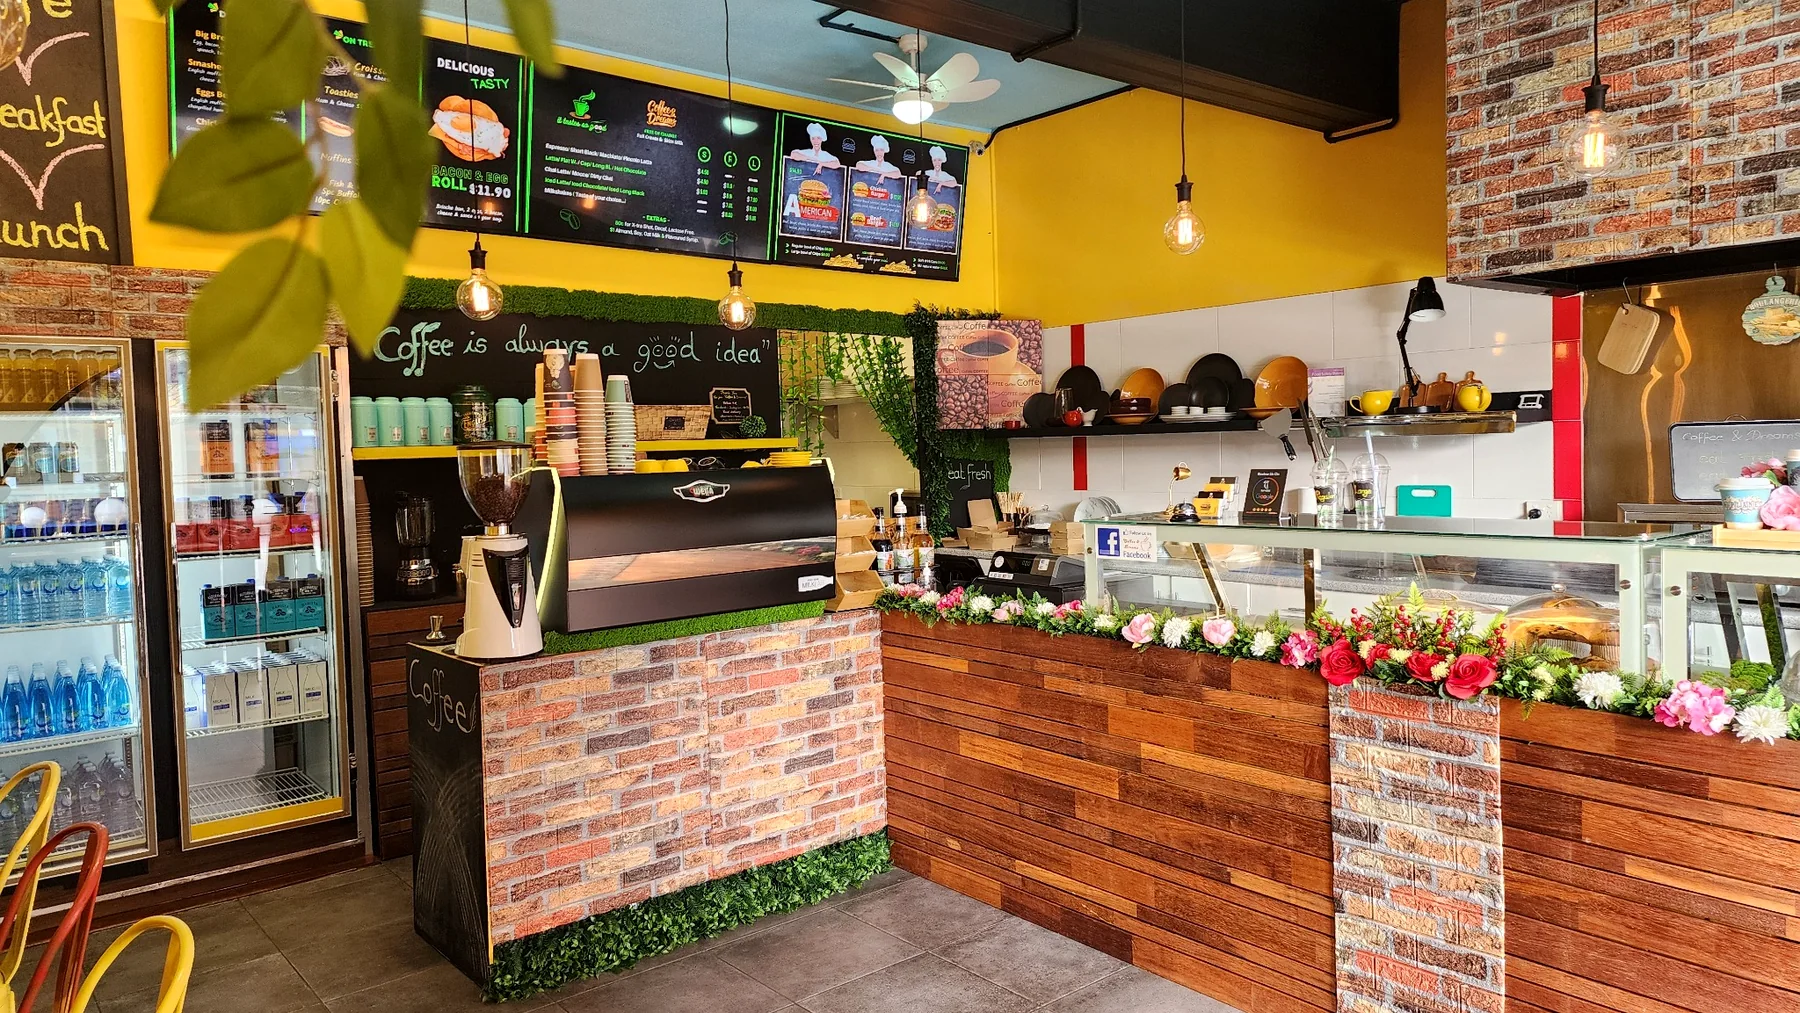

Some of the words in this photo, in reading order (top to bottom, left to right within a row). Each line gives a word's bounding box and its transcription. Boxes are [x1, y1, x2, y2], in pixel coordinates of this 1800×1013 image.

[195, 30, 210, 40] Big
[342, 36, 356, 45] ON
[187, 58, 222, 70] Smashe
[437, 57, 495, 77] DELICIOUS
[196, 87, 215, 98] Eggs
[324, 85, 360, 99] Toasties
[431, 165, 473, 180] BACON
[474, 170, 484, 181] &
[485, 172, 509, 184] EGG
[431, 175, 467, 191] ROLL
[469, 183, 511, 199] $11.90
[783, 194, 832, 217] AMERICAN
[373, 321, 454, 377] Coffee
[463, 331, 488, 354] is
[601, 343, 620, 356] a
[633, 331, 701, 373] good
[1682, 432, 1724, 444] Coffee
[1731, 429, 1743, 441] &
[948, 463, 966, 480] eat
[963, 462, 992, 490] fresh
[1256, 492, 1274, 500] Google
[1123, 551, 1151, 560] Facebook
[410, 659, 478, 733] Coffee
